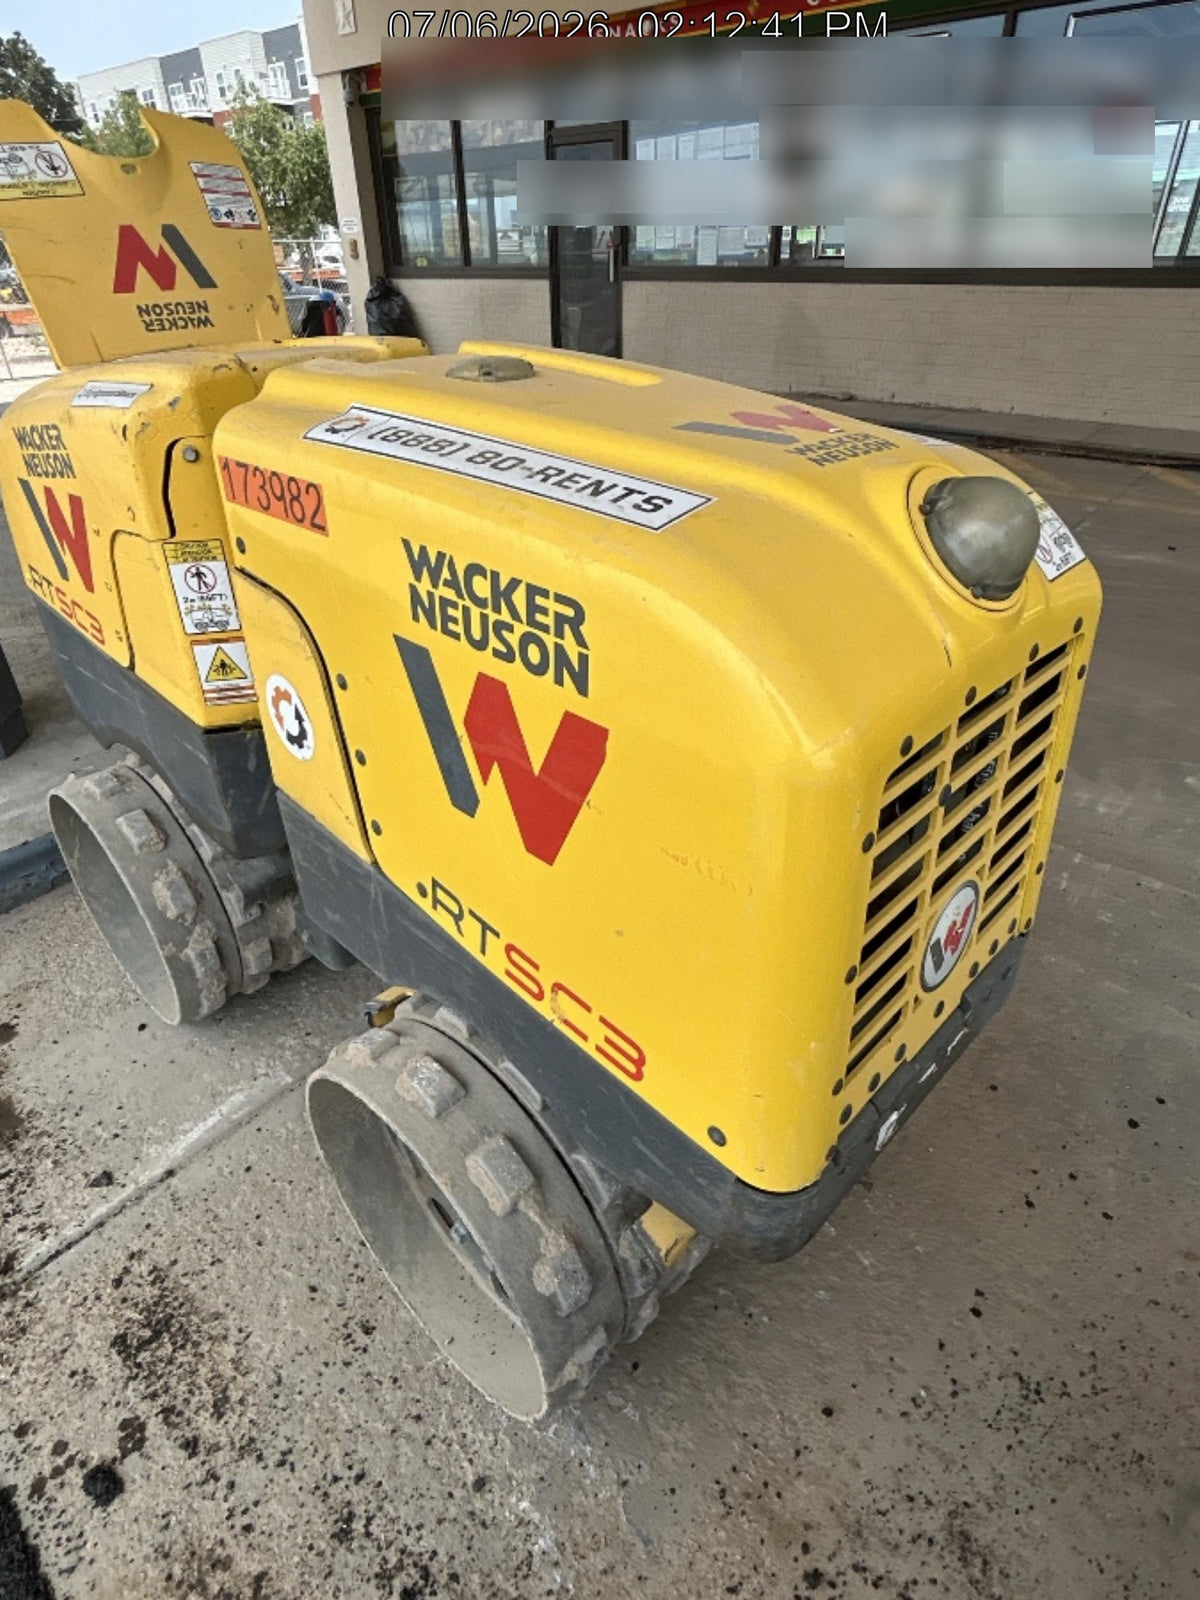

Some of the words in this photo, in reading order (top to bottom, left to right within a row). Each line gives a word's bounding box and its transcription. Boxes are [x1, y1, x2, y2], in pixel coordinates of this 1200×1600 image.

[136, 300, 210, 318] NEUSON
[141, 316, 215, 332] WACKER
[12, 423, 68, 452] WACKER
[22, 452, 77, 479] NEUSON
[367, 426, 471, 457] (888)
[465, 450, 673, 513] 80-RENTS
[807, 439, 900, 467] NEUSON
[222, 456, 327, 532] 173982
[27, 563, 105, 646] RTSC3
[401, 537, 590, 650] WACKER
[408, 583, 589, 698] NEUSON
[431, 876, 647, 1082] RTSC3
